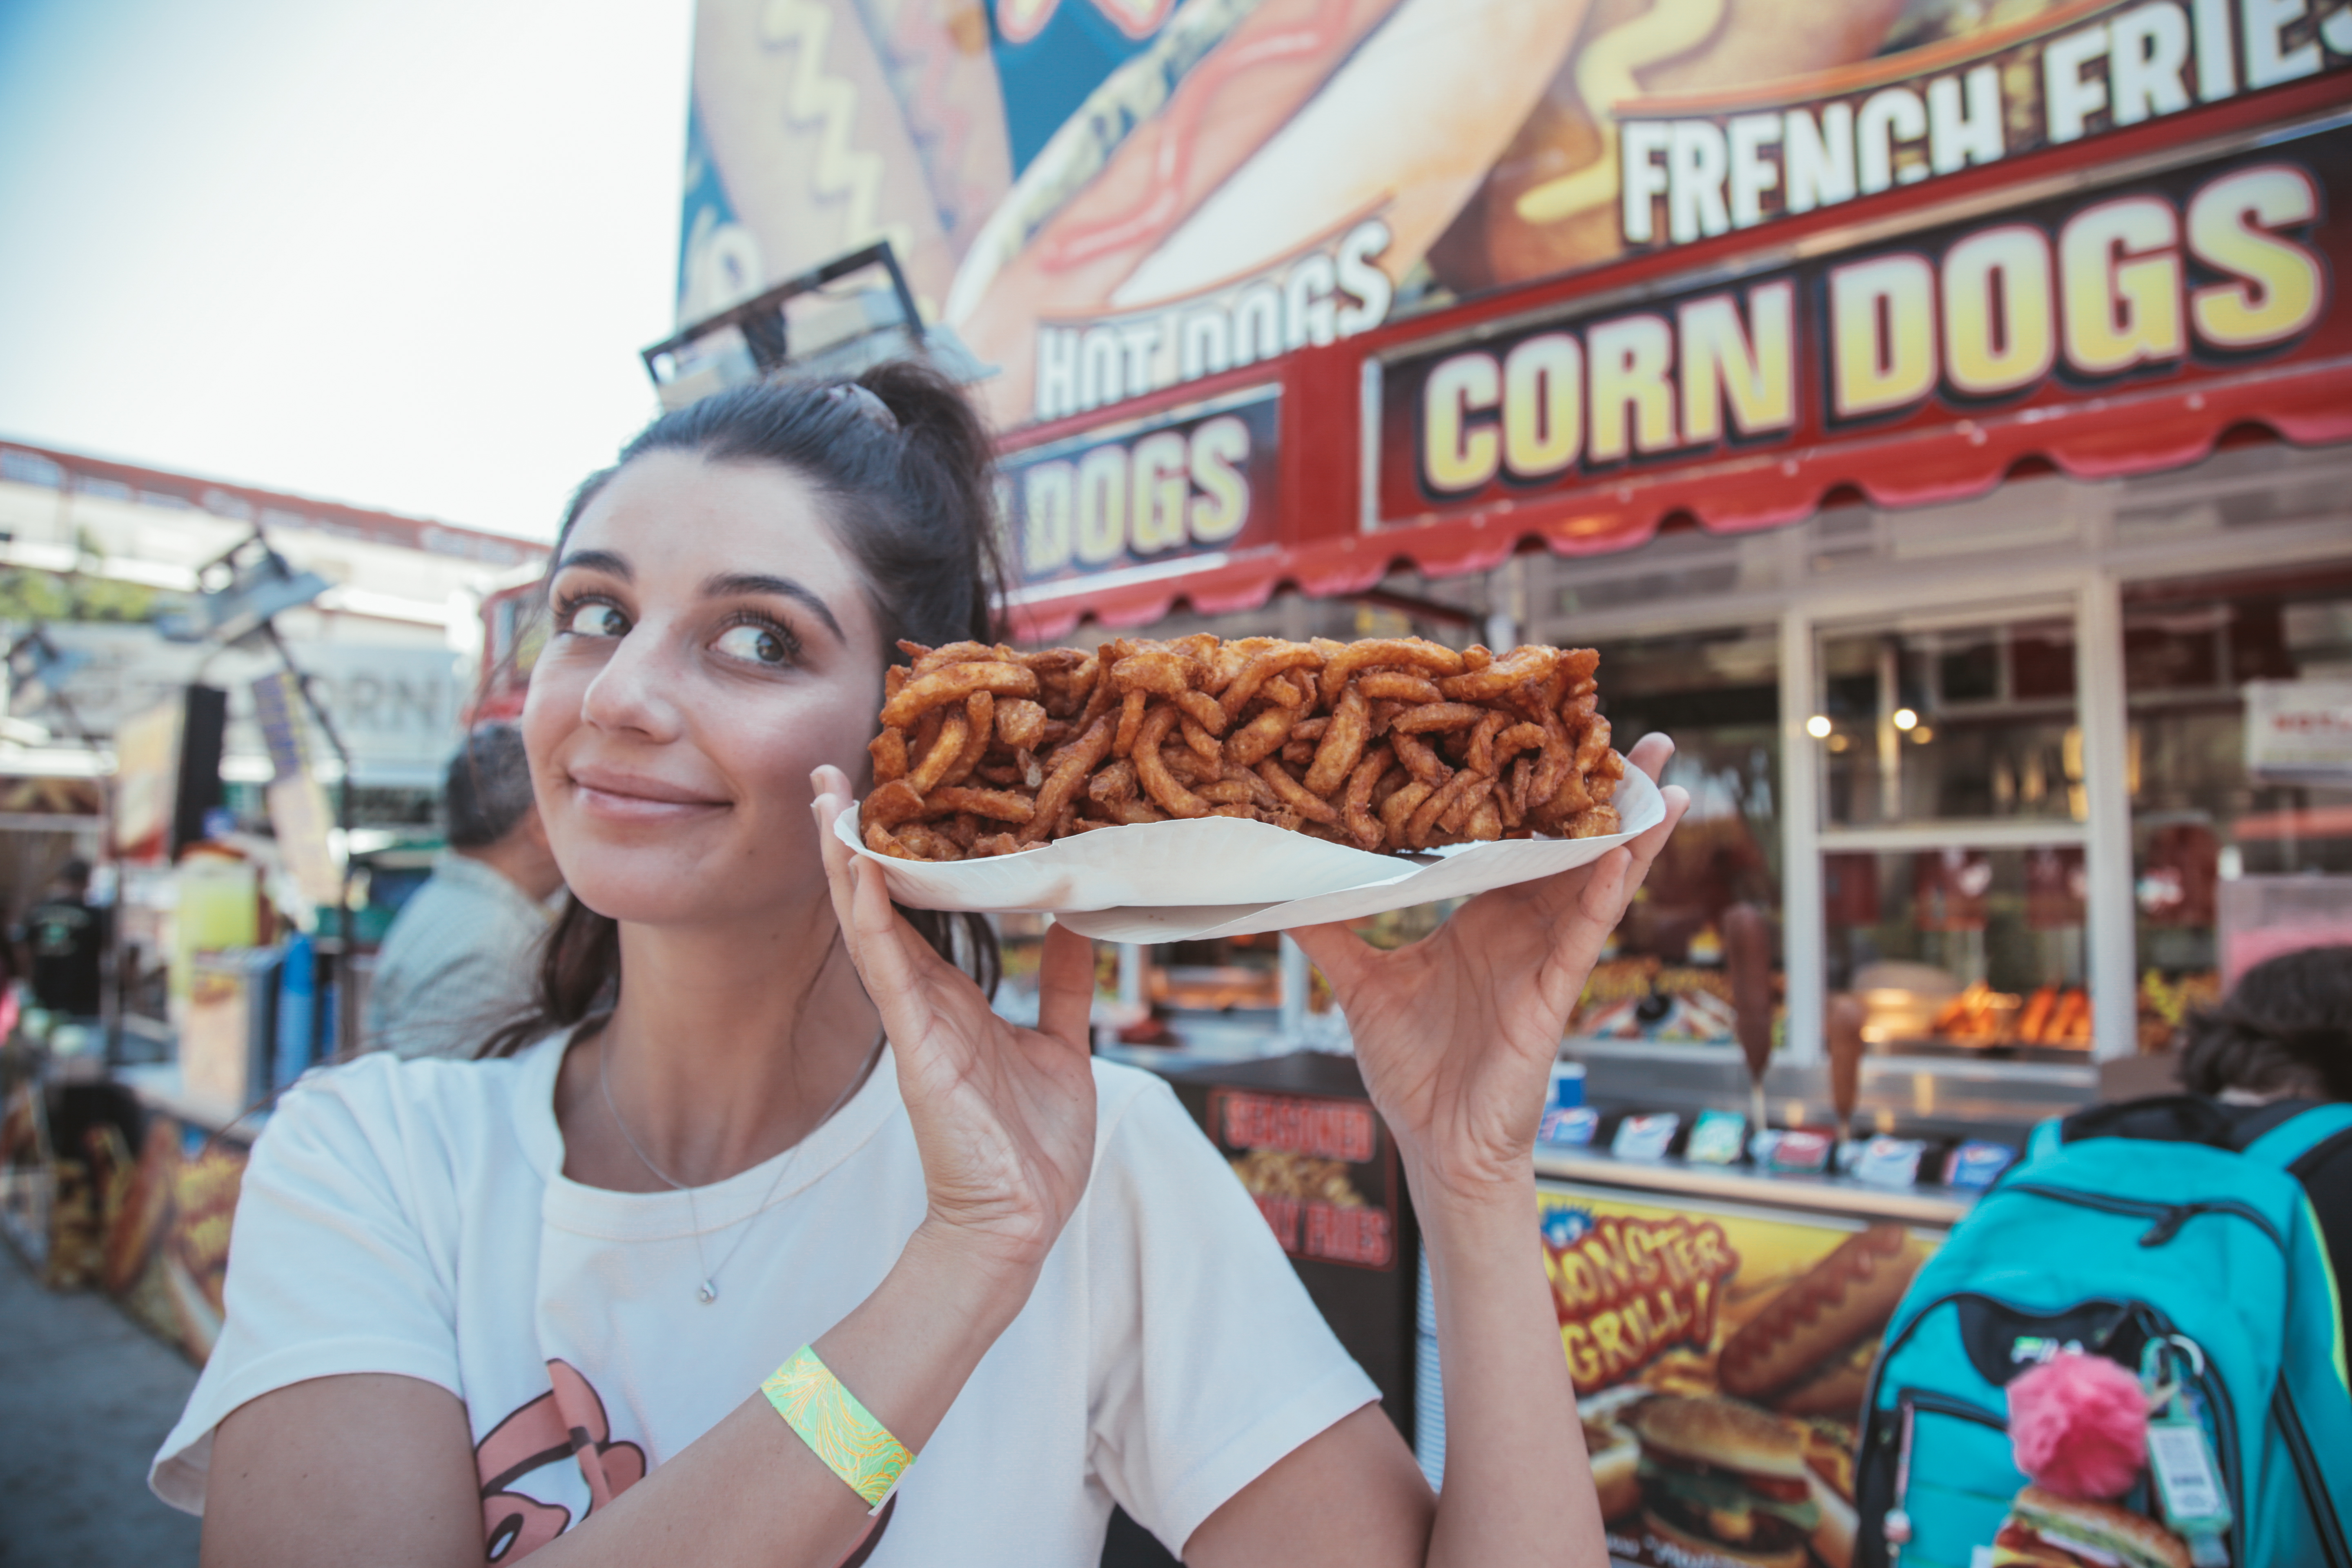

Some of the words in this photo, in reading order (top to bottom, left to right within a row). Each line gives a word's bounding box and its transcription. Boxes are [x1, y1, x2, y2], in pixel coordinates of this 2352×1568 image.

[1621, 62, 2006, 245] FRENCH
[1037, 325, 1159, 421] HOT
[1425, 280, 1796, 494] CORN
[1829, 164, 2324, 418] DOGS
[1024, 414, 1250, 572] DOGS
